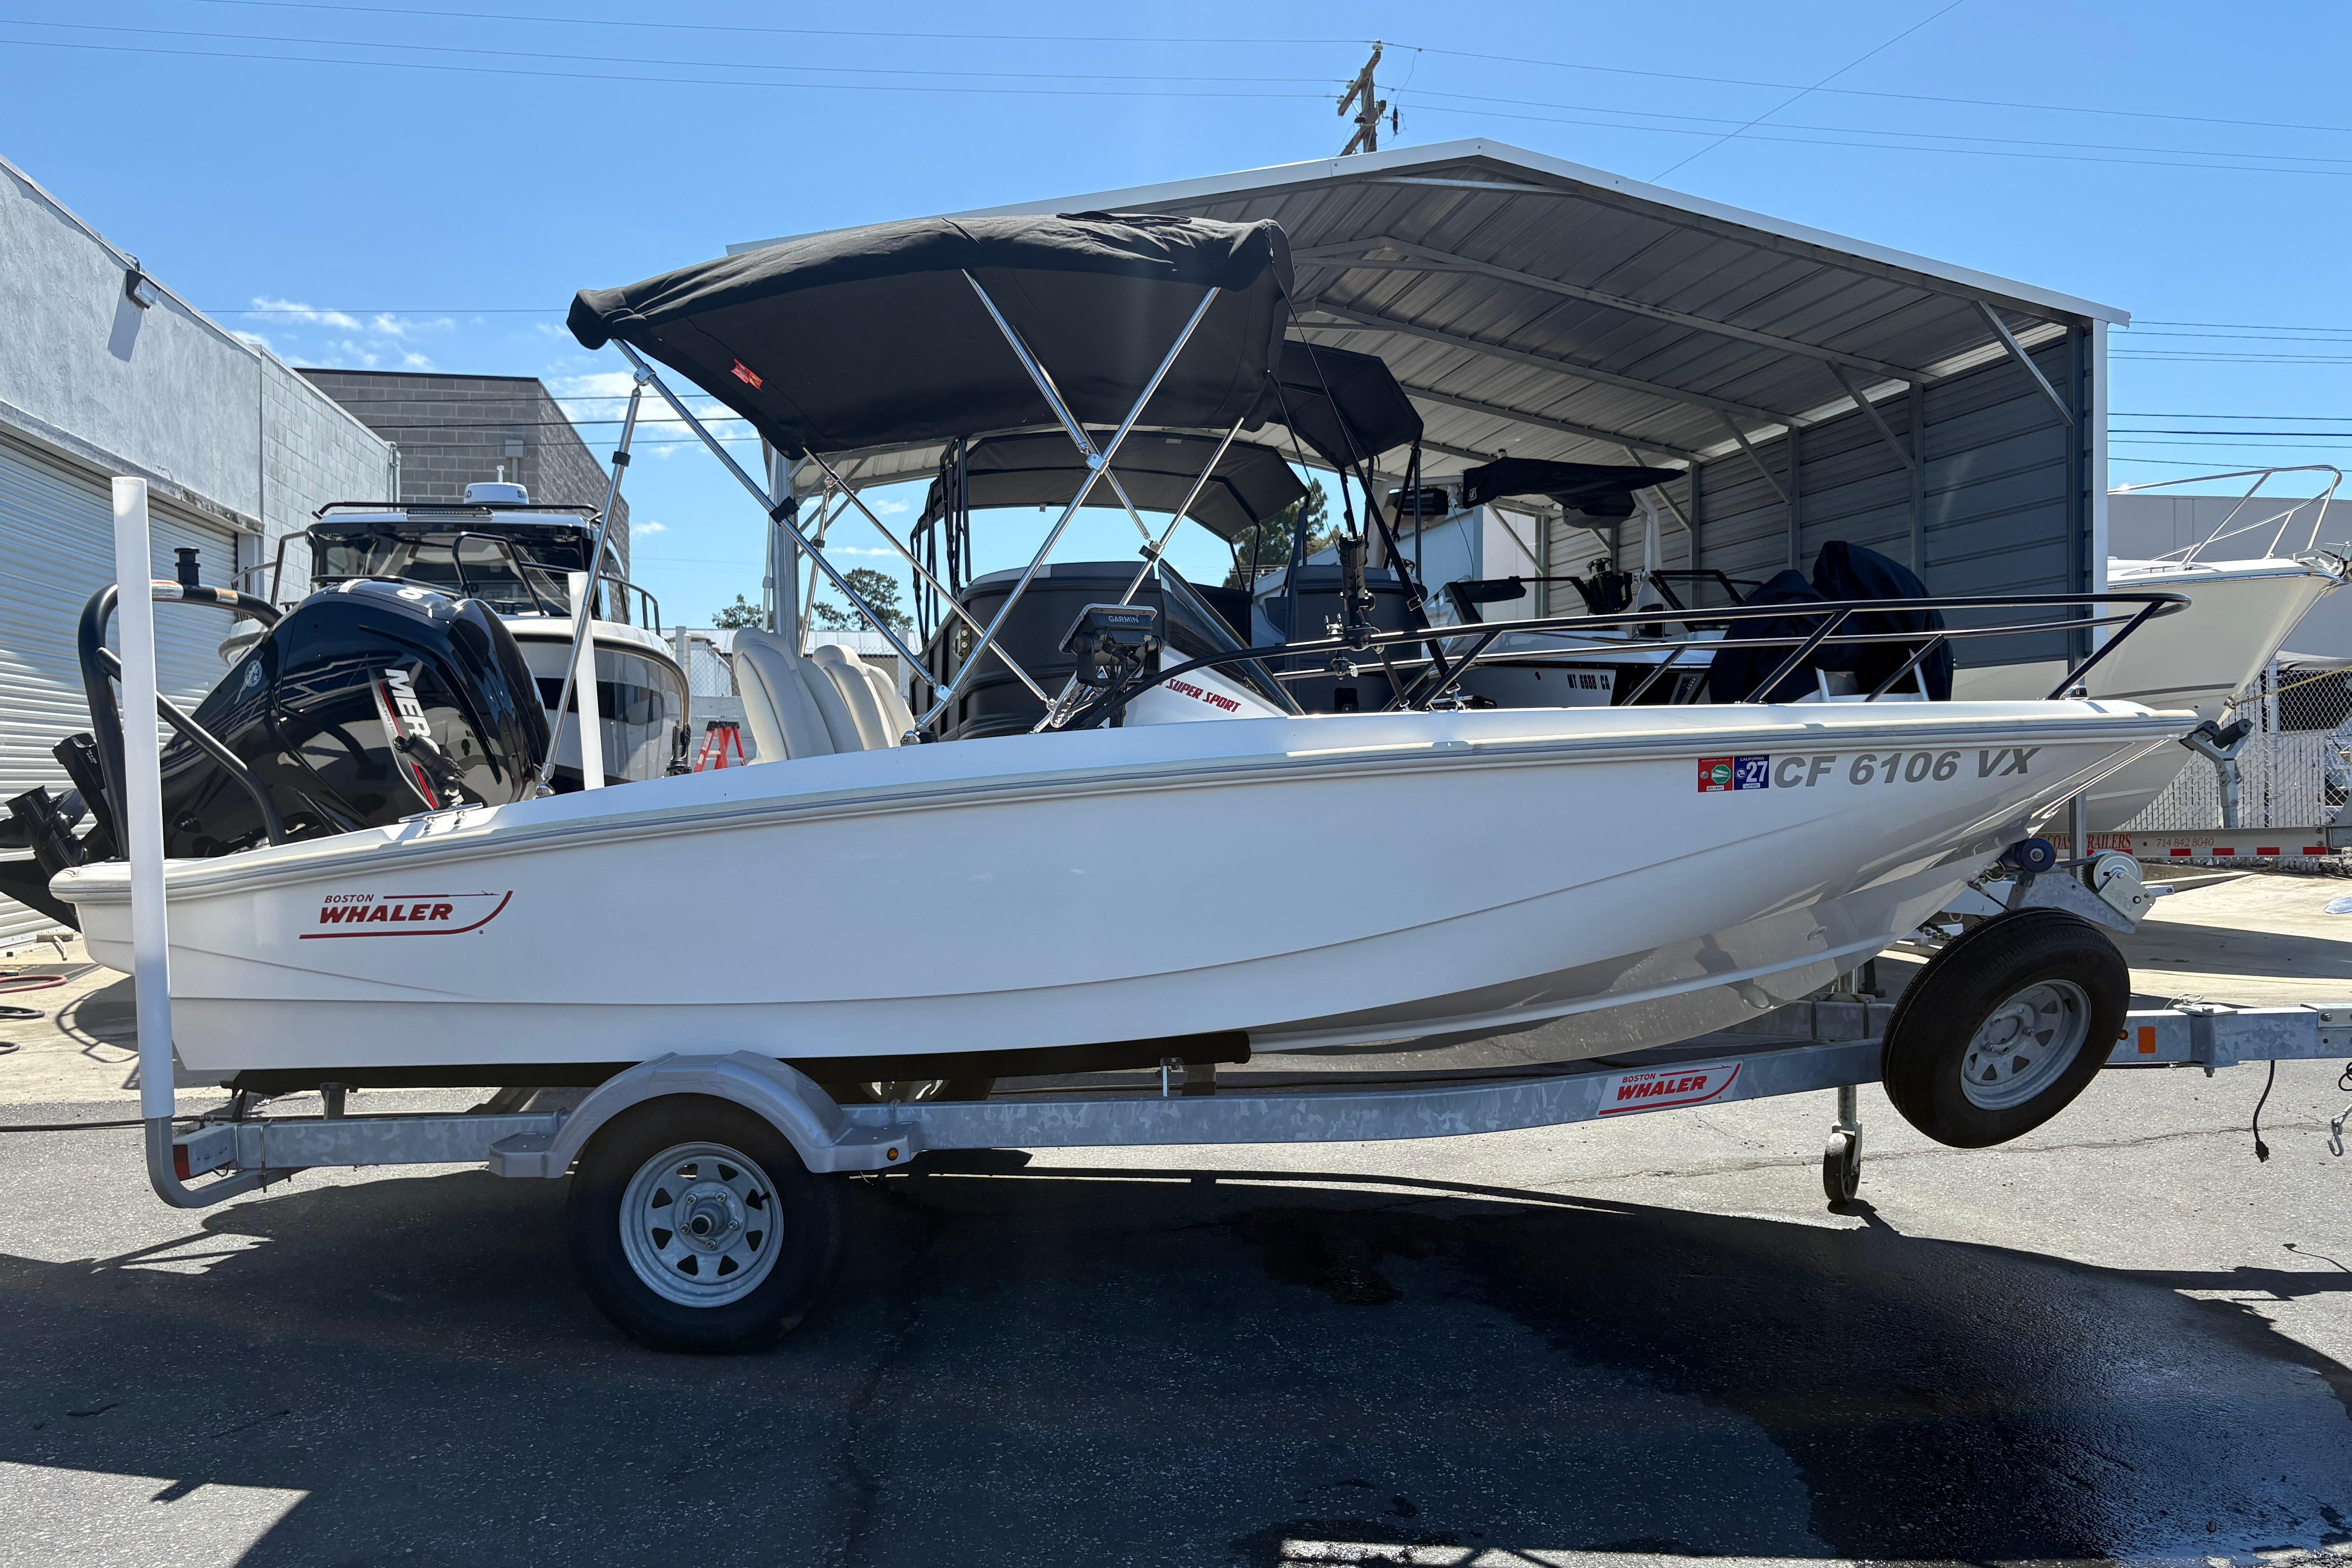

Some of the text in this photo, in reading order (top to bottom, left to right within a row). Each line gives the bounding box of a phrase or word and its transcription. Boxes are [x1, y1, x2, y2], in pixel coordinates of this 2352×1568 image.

[1108, 615, 1139, 623] GARMIN
[1600, 675, 1610, 690] CA
[1165, 678, 1241, 713] SUPER SPORT
[1746, 761, 1768, 783] 27
[1773, 747, 2042, 788] CF 6106 VX
[2086, 834, 2132, 849] RAILERS
[2156, 837, 2214, 847] 714 842 8040
[324, 894, 374, 903] BOSTON
[320, 903, 453, 924] WHALER
[1622, 1073, 1656, 1083] BOSTON
[1617, 1075, 1708, 1101] WHALER
